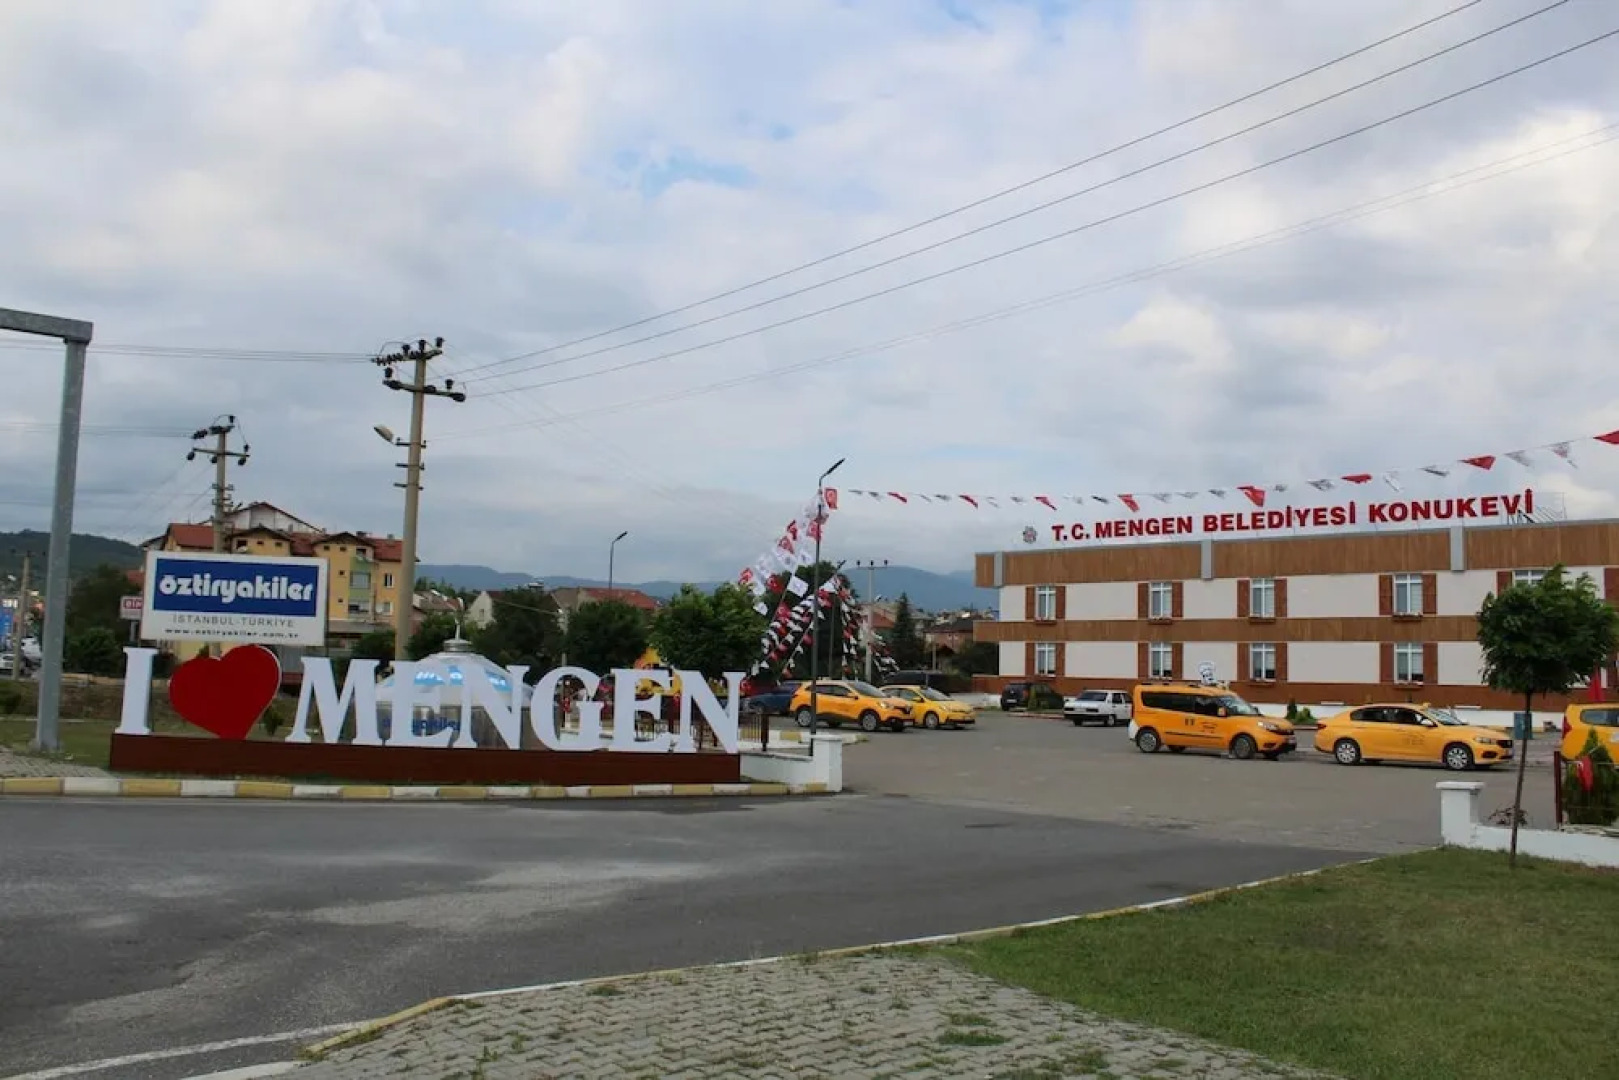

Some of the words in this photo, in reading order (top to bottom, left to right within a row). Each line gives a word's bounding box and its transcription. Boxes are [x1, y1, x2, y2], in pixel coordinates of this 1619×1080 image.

[1095, 516, 1193, 539] MENGEN
[1203, 501, 1356, 532] BELEDİYESİ
[1368, 488, 1534, 523] KONUKEVİ
[159, 572, 314, 604] öztiryakiler
[115, 647, 158, 735] I
[285, 656, 747, 754] MENGEN
